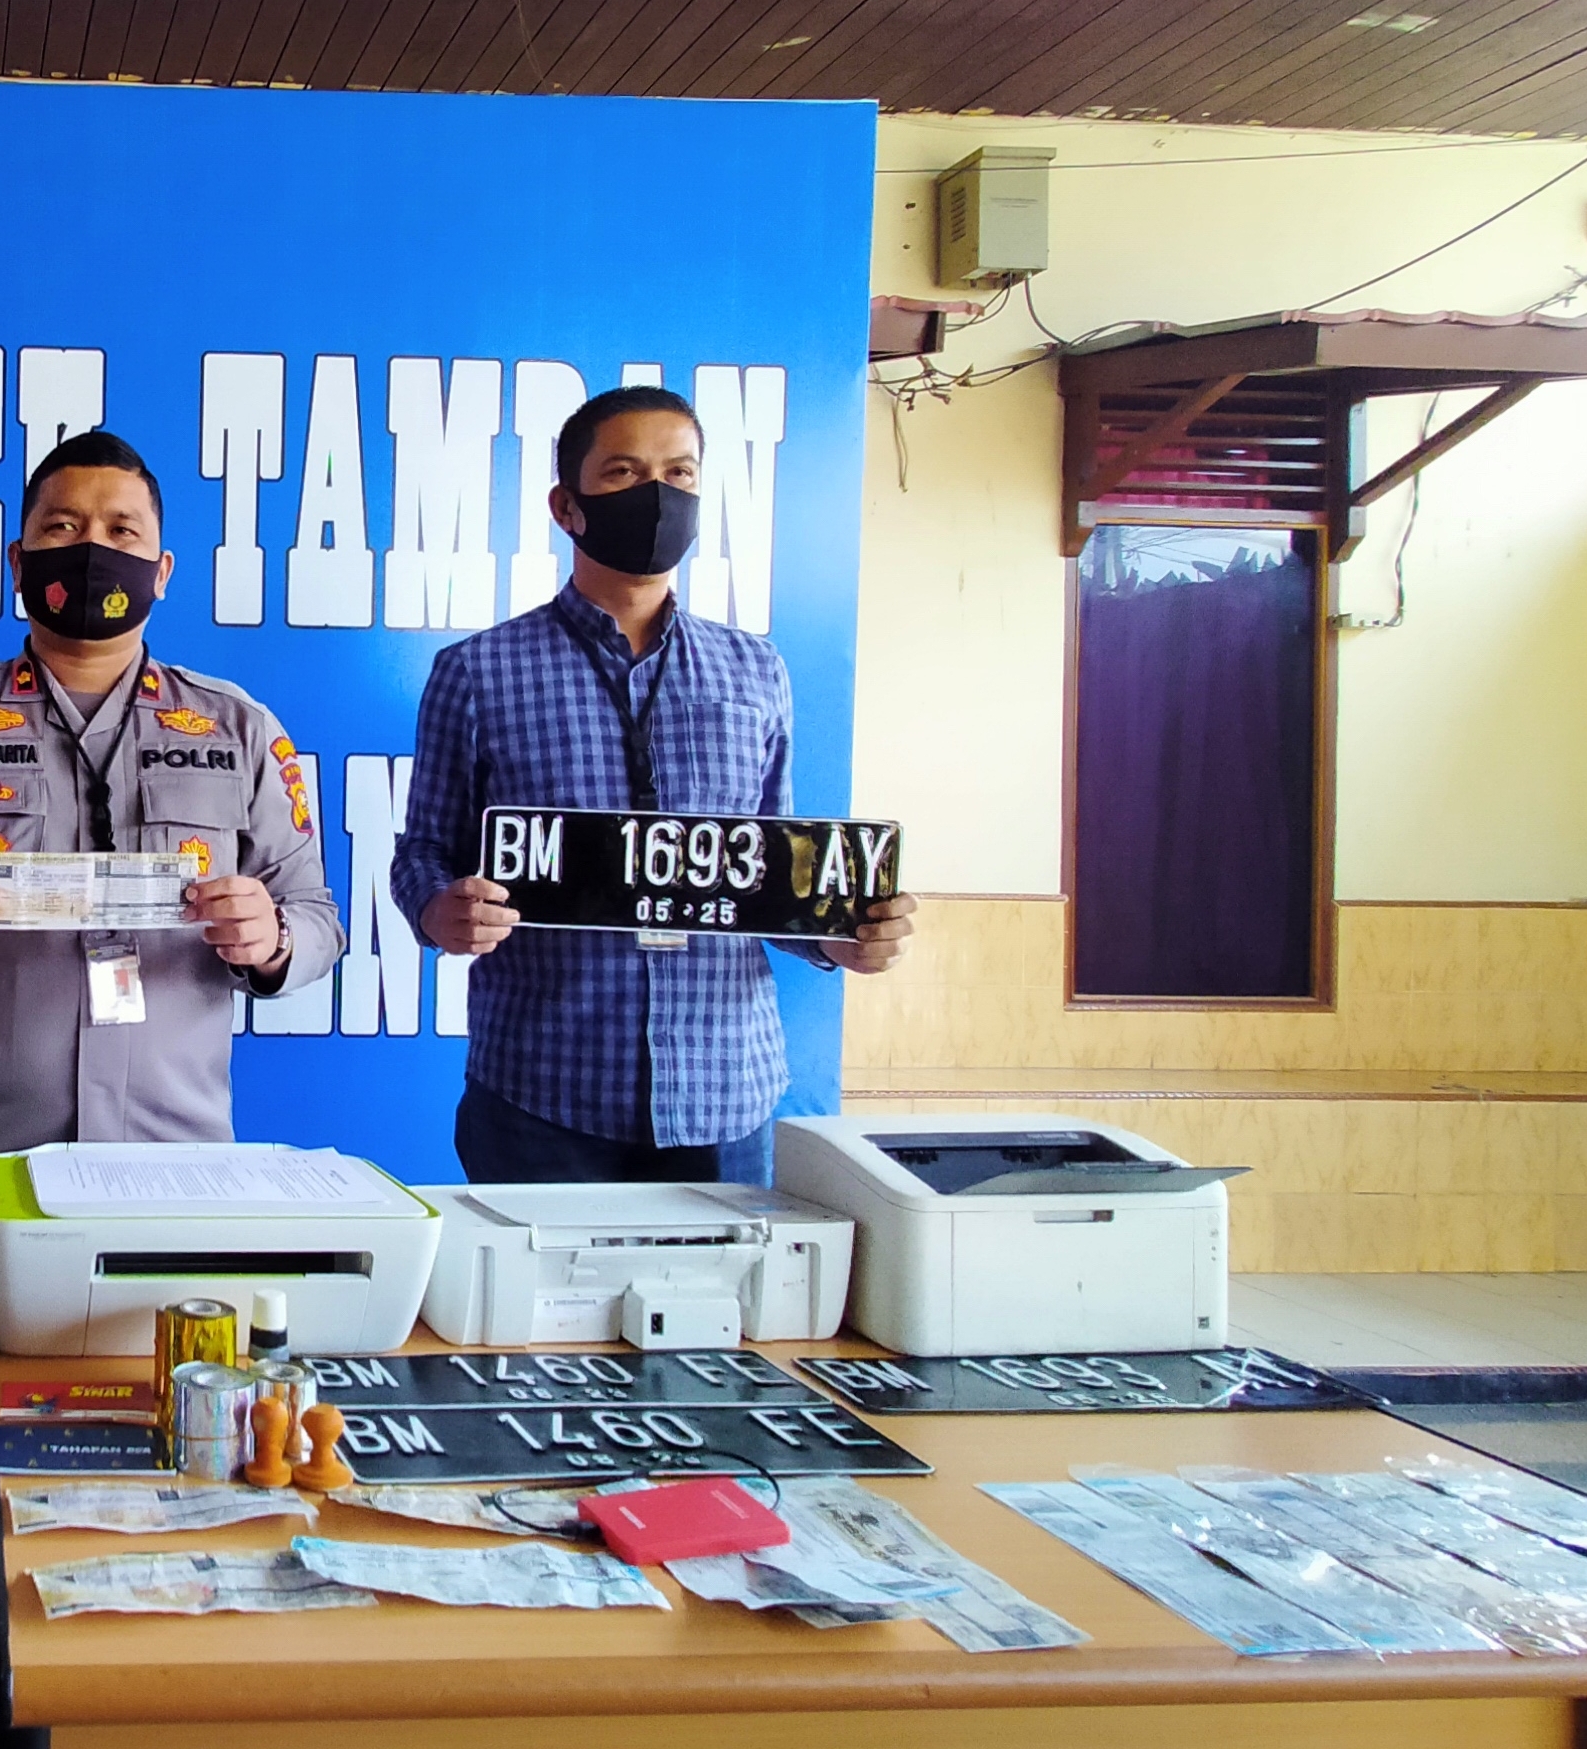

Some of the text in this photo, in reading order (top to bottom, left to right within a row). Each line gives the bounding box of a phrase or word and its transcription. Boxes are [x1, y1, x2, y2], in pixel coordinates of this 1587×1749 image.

[201, 352, 787, 634] TAMPN
[141, 748, 237, 771] POLRI
[493, 815, 890, 898] BM 1693 AY
[316, 1352, 794, 1389] BM 1460 FE
[812, 1359, 934, 1392] BM
[959, 1357, 1168, 1391] 1693
[68, 1384, 134, 1399] SINAR
[49, 1444, 122, 1454] TAHAPAN
[341, 1407, 883, 1456] BM 1460 FE
